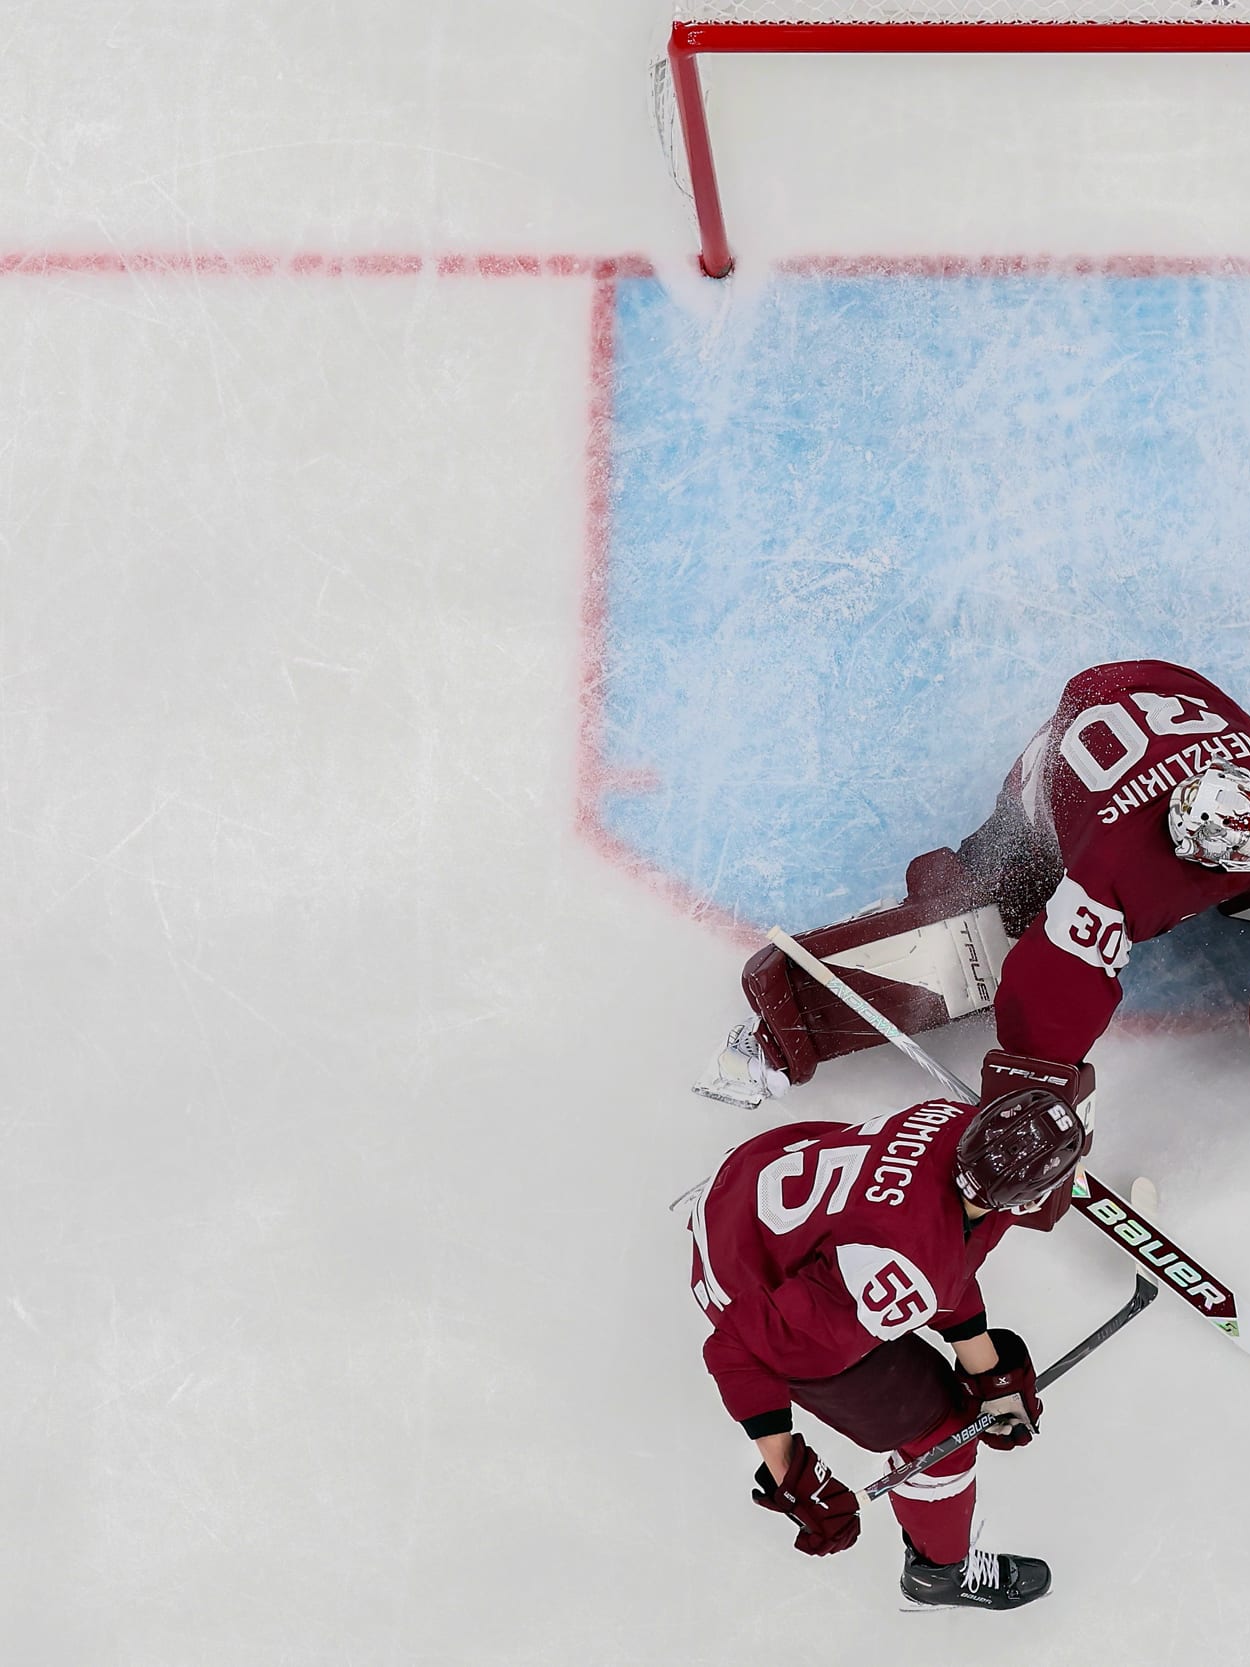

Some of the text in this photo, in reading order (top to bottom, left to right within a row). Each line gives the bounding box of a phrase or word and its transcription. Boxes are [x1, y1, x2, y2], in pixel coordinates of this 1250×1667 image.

[1061, 692, 1229, 792] 30
[962, 921, 991, 1003] TRUE
[1069, 906, 1122, 964] 30
[987, 1063, 1069, 1087] TRUE
[865, 1102, 964, 1207] MAMCICS
[1048, 1104, 1074, 1132] 55
[757, 1114, 890, 1235] 5
[955, 1174, 977, 1200] 55
[1086, 1198, 1227, 1311] BAUER
[862, 1260, 928, 1327] 55
